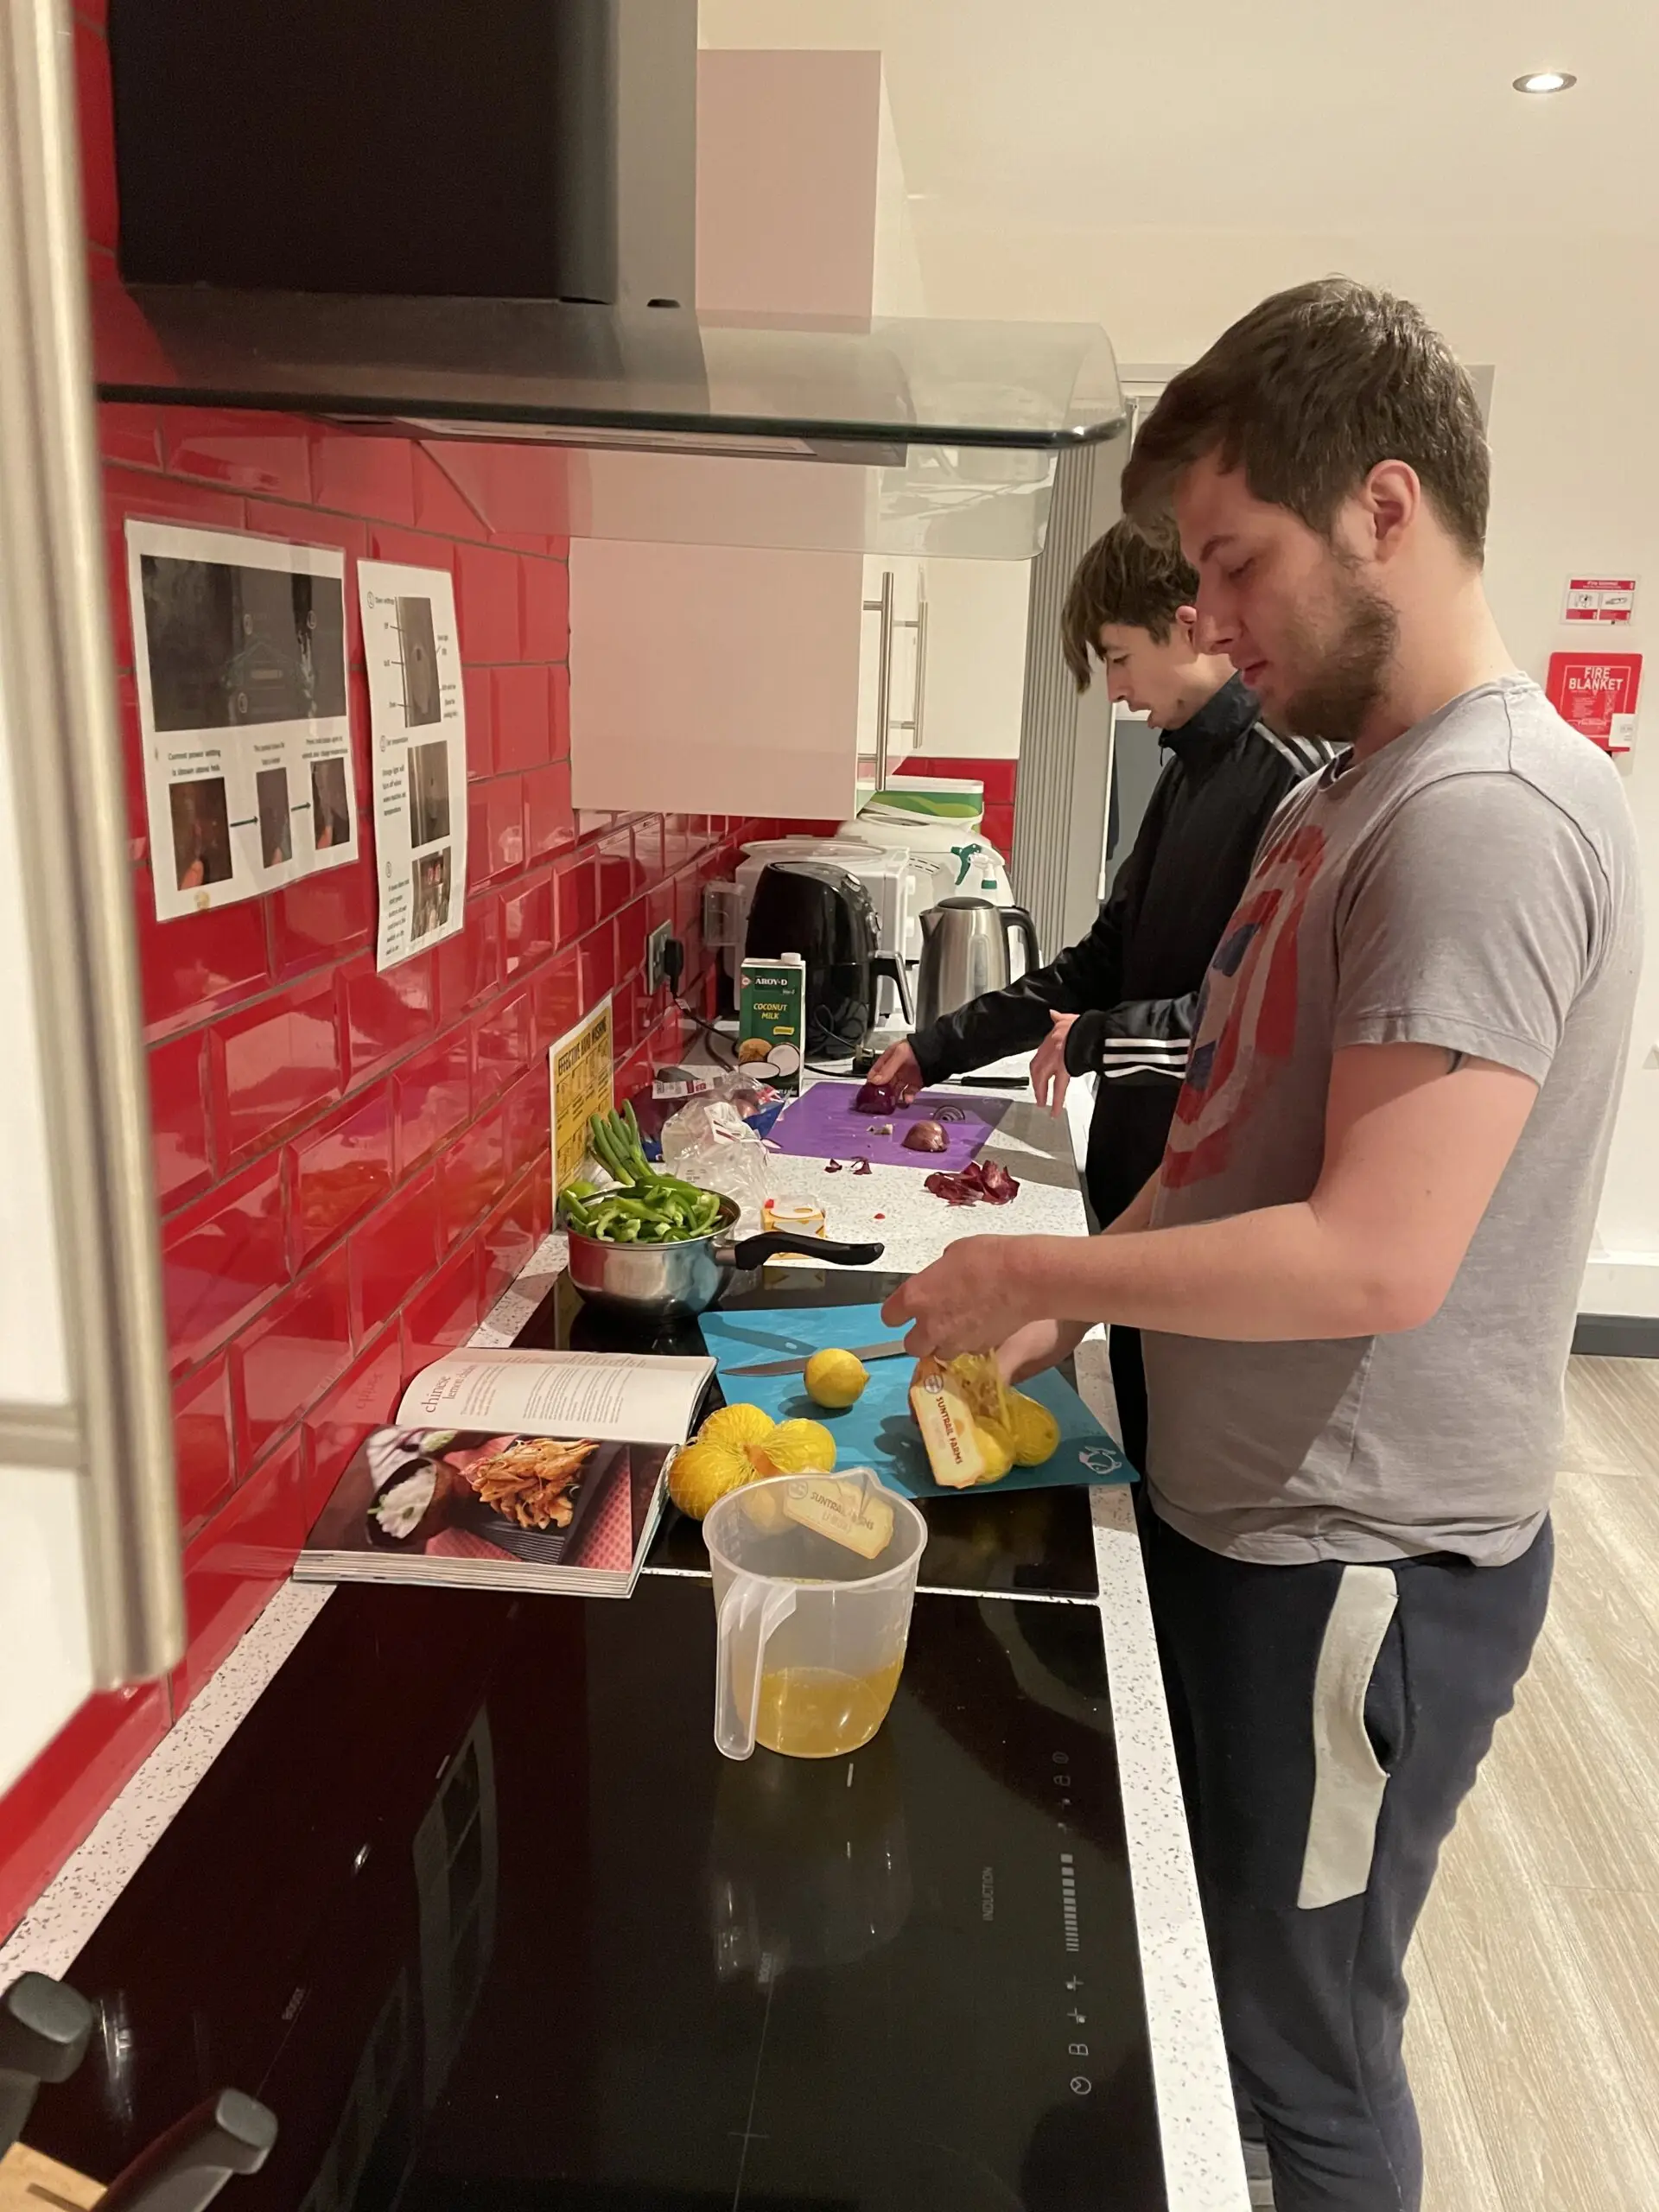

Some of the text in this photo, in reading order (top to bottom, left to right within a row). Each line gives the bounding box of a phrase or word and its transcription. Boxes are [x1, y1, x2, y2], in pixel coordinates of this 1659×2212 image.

[1568, 677, 1624, 691] BLANKET
[1584, 666, 1611, 679] FIRE
[422, 1376, 451, 1413] chinese
[442, 1378, 462, 1400] lemon
[936, 1396, 954, 1436] SUNTRAIL
[950, 1437, 963, 1465] FARMS
[982, 1866, 994, 1921] INDUCTION
